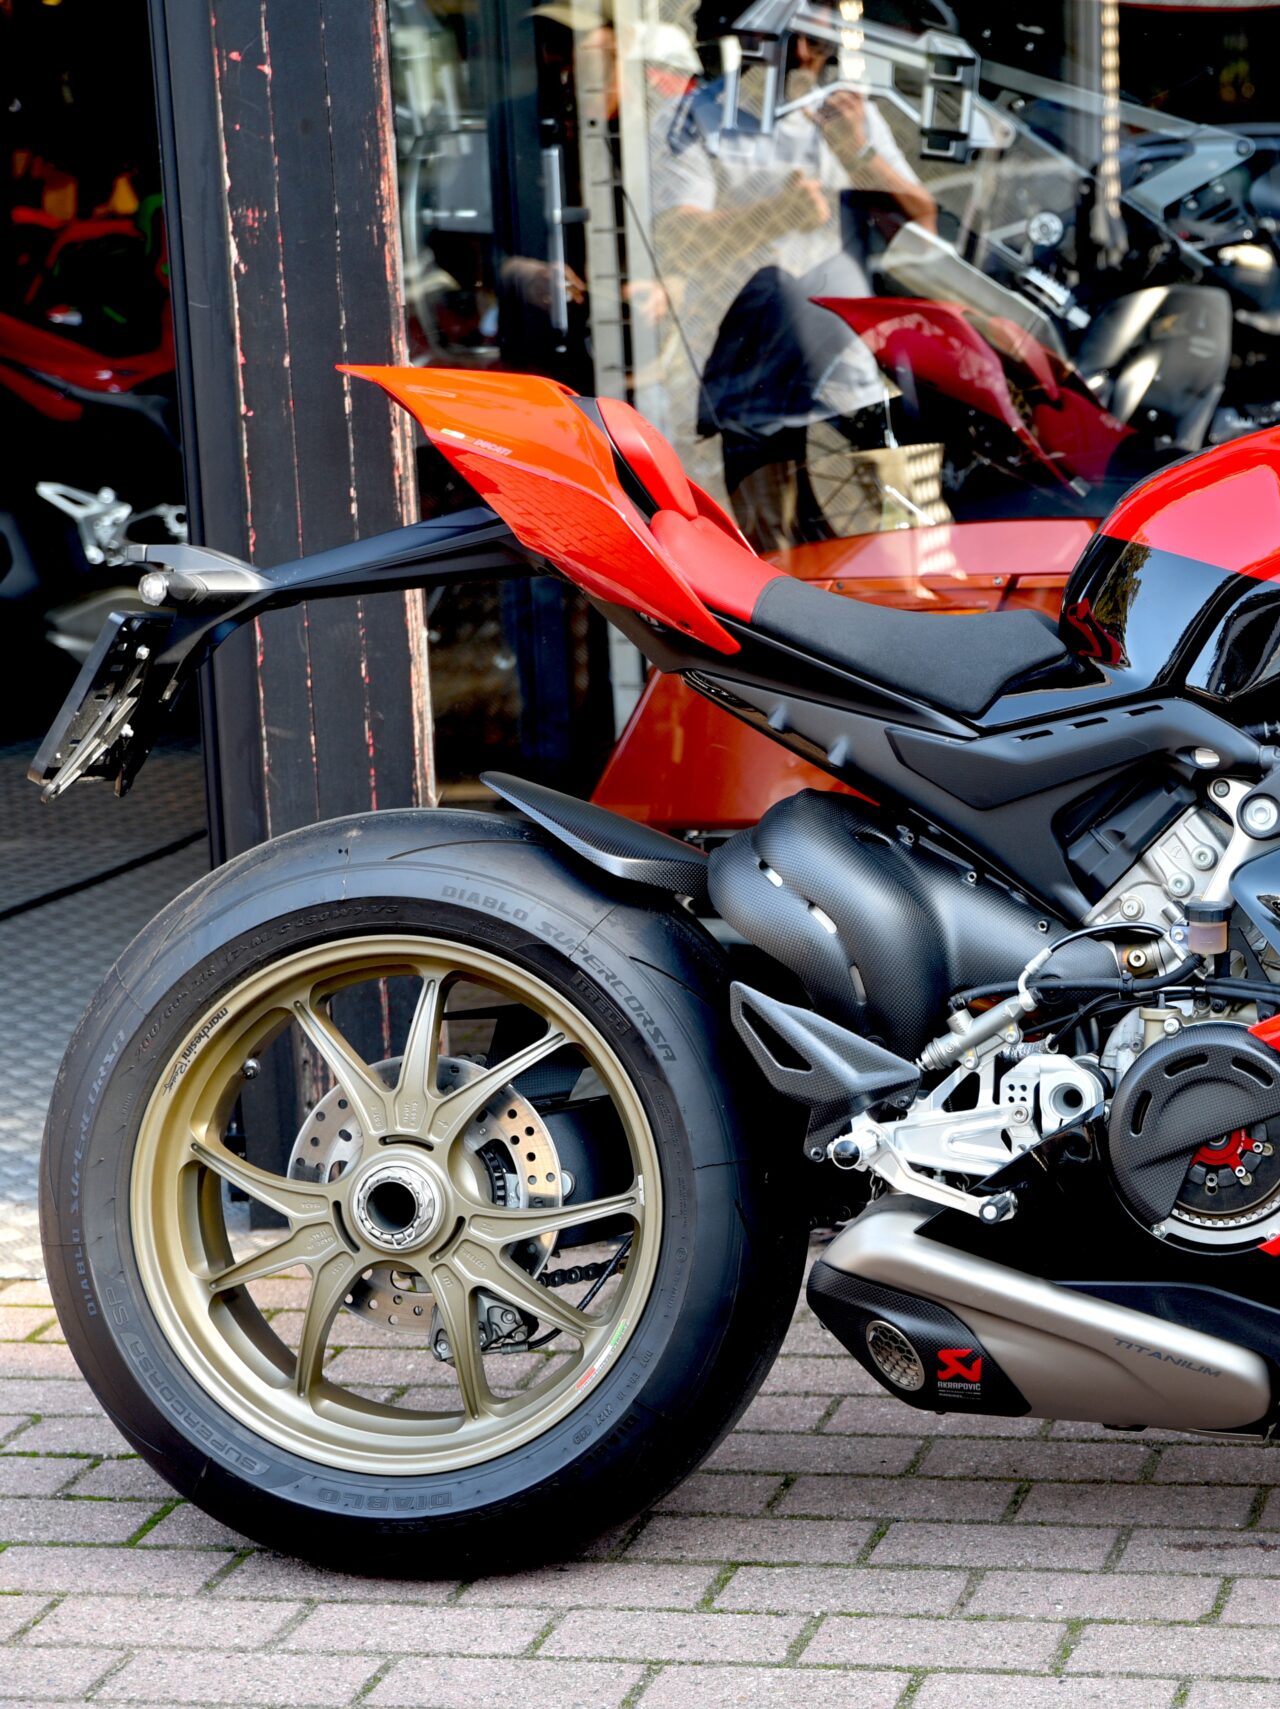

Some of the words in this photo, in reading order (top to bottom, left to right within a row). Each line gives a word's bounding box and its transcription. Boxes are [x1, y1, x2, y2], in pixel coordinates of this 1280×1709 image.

[472, 438, 513, 457] DUCATI
[440, 885, 530, 921] DIABLO
[535, 920, 677, 1062] SUPERCORSA
[182, 1008, 229, 1063] marchesini
[72, 1229, 98, 1316] DIABLO
[105, 1287, 128, 1326] SP
[1113, 1338, 1222, 1378] TITANIUM
[130, 1340, 258, 1472] SUPERCORSA
[318, 1487, 452, 1511] DIABLO
